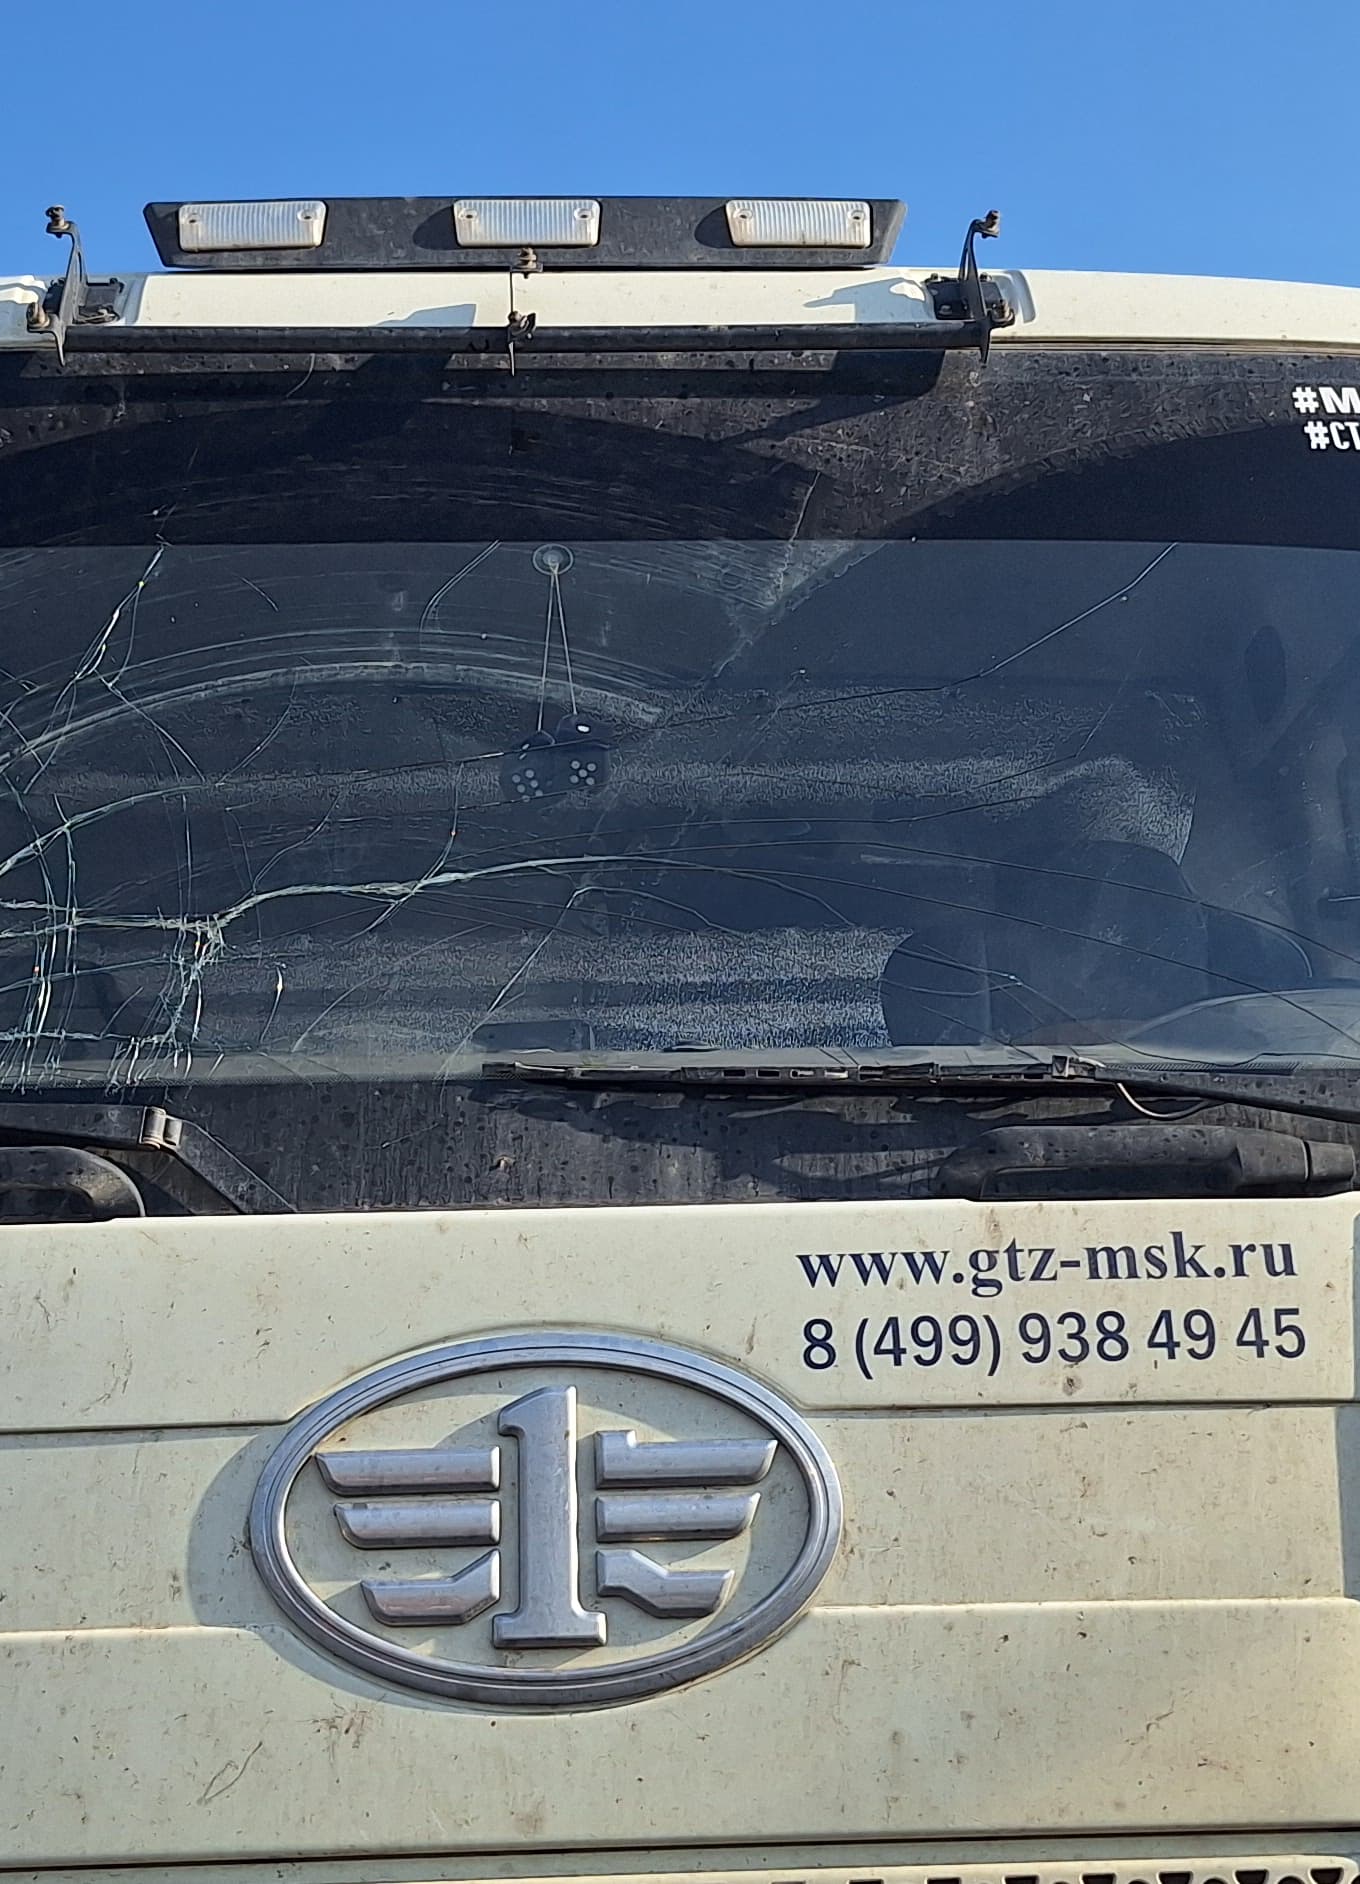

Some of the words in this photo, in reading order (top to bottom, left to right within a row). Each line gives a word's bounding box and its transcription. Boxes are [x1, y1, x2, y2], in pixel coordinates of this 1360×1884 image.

[796, 1231, 1298, 1298] www.gtz-msk.ru
[802, 1318, 837, 1370] 8
[854, 1314, 1001, 1380] (499)
[1018, 1311, 1129, 1364] 938
[1147, 1309, 1216, 1360] 49
[1236, 1307, 1306, 1359] 45
